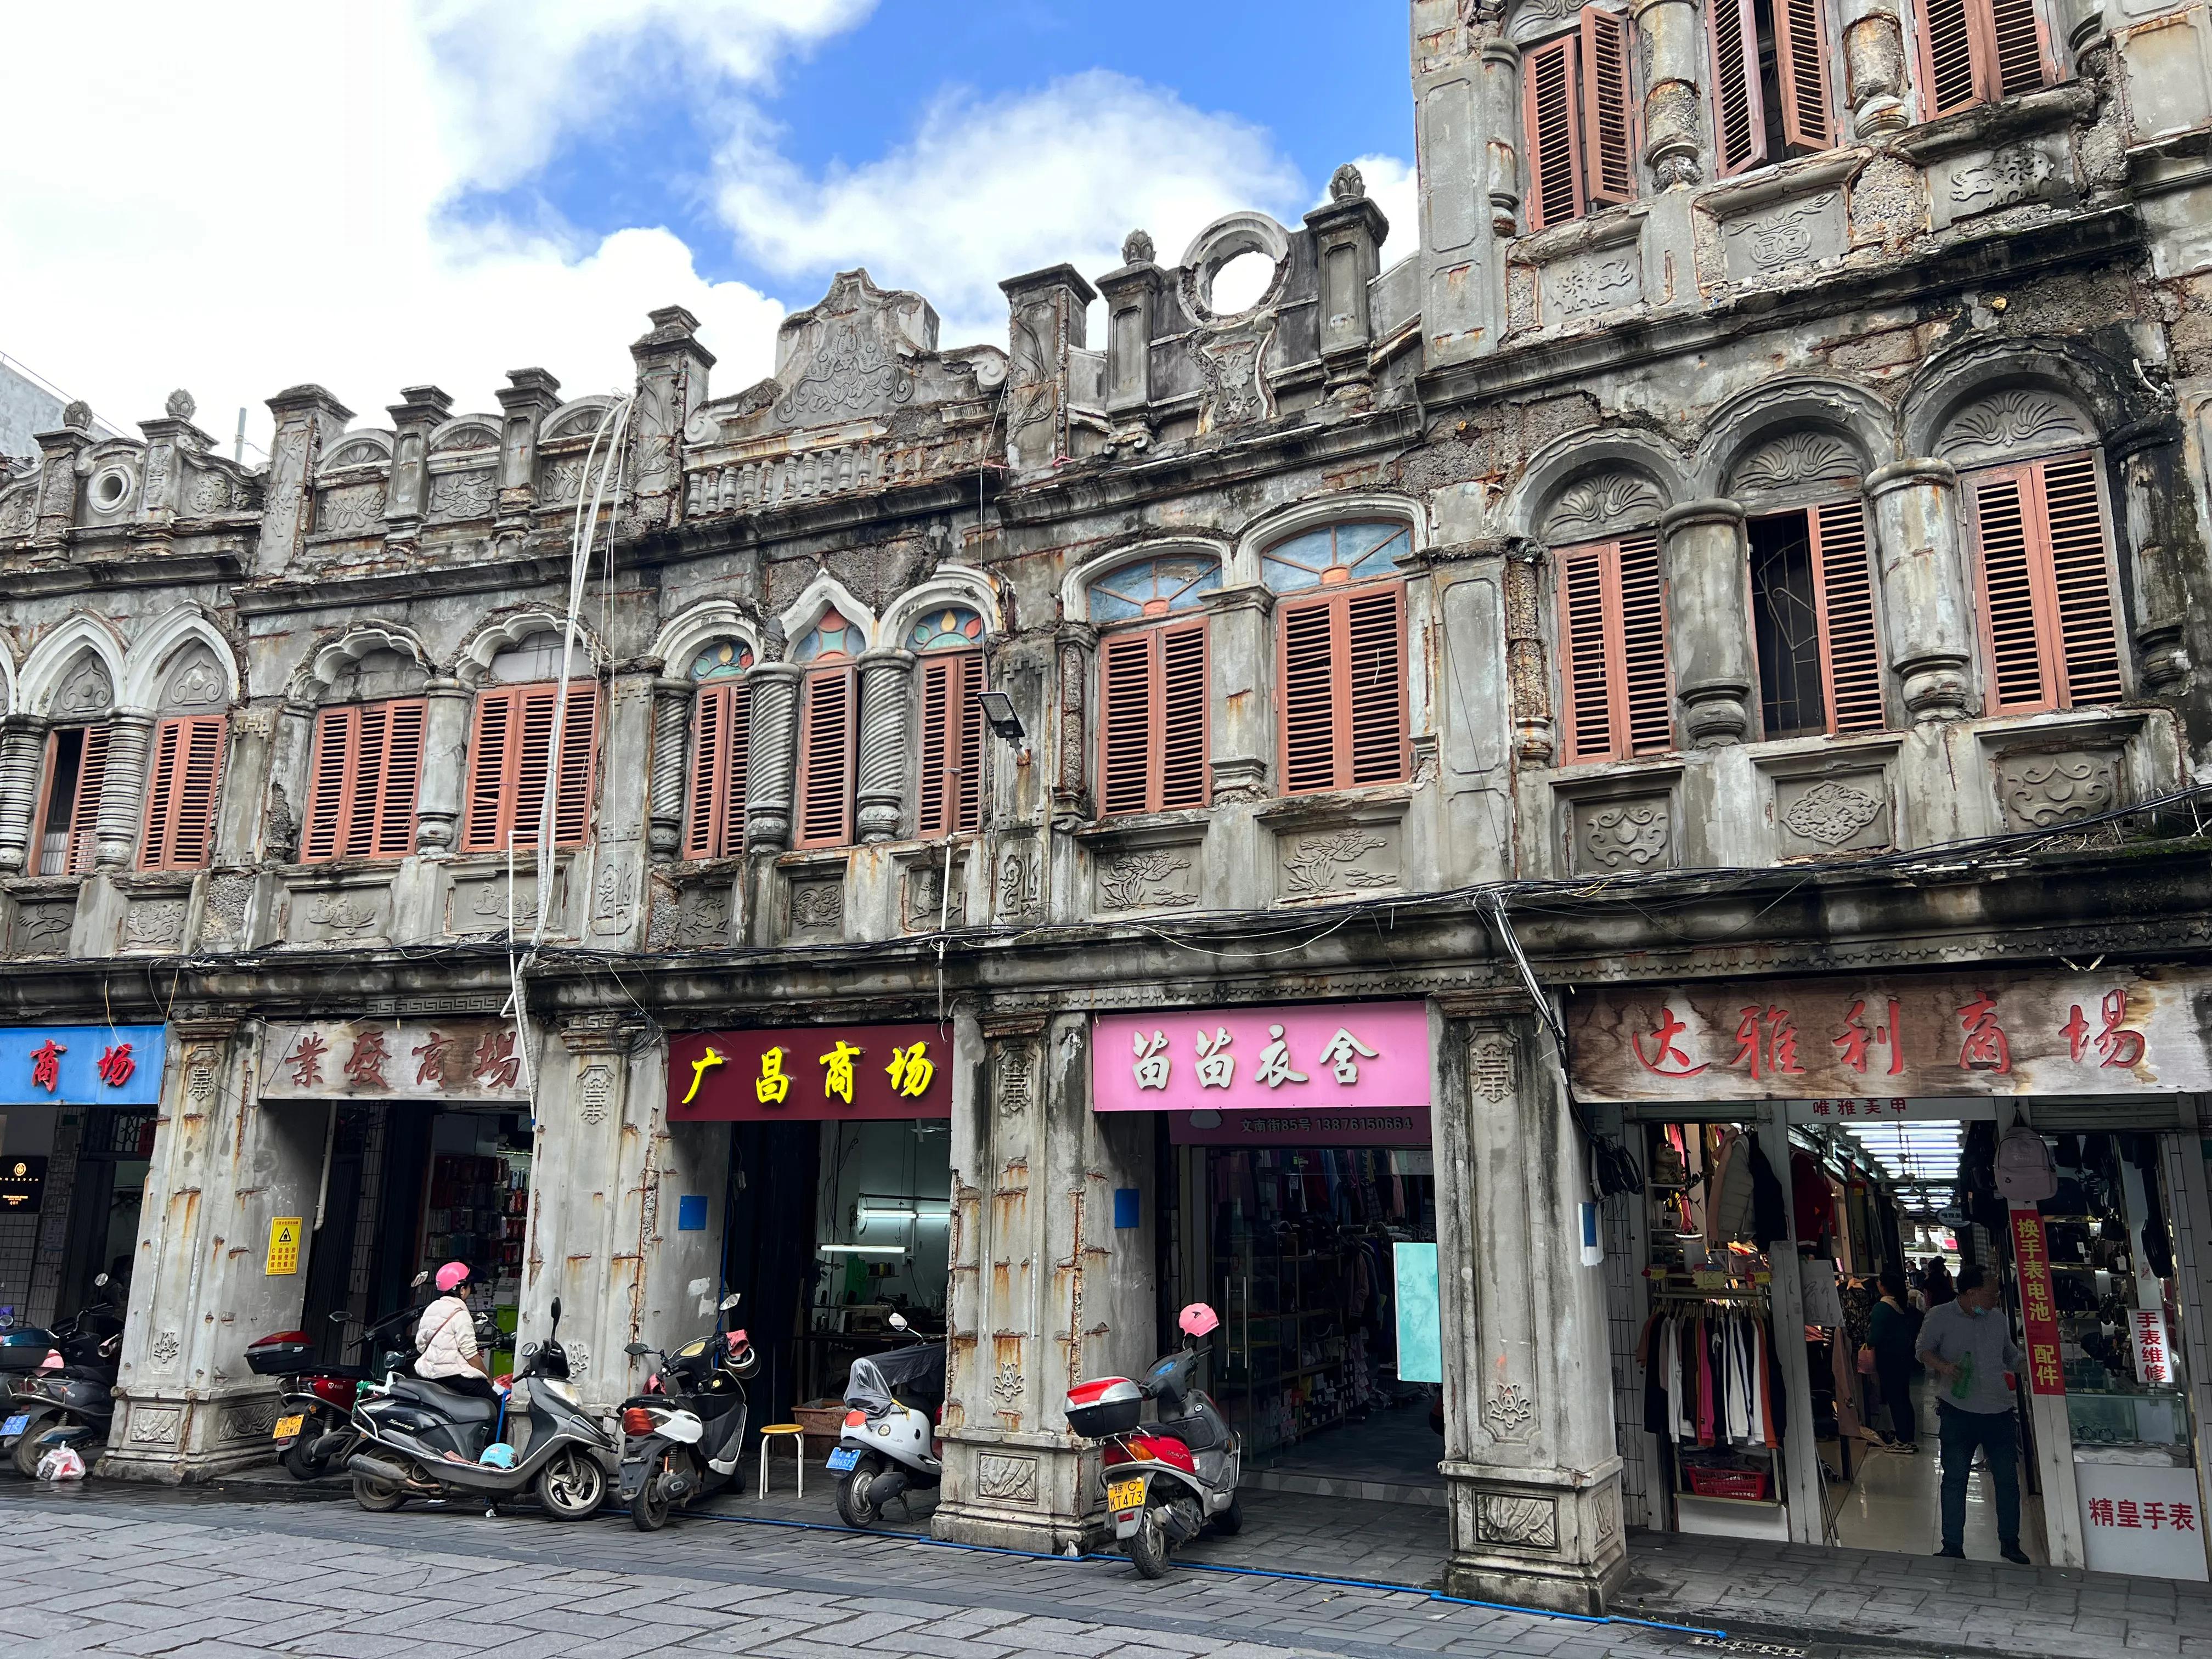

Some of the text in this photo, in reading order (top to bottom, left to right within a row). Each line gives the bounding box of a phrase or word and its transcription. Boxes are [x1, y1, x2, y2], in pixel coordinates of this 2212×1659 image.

[30, 1039, 136, 1092] 商场
[681, 1041, 934, 1104] 广昌商场
[1132, 1024, 1379, 1089] 苗苗衣舍
[1240, 1117, 1412, 1132] 文南街85号 13876150664
[1813, 1097, 1906, 1116] 唯雅美甲
[2017, 1218, 2051, 1322] 换手表电池
[2033, 1344, 2058, 1386] 配件
[2136, 1312, 2166, 1381] 手表维修
[1110, 1491, 1143, 1510] KT473
[2088, 1497, 2195, 1532] 精皇手表
